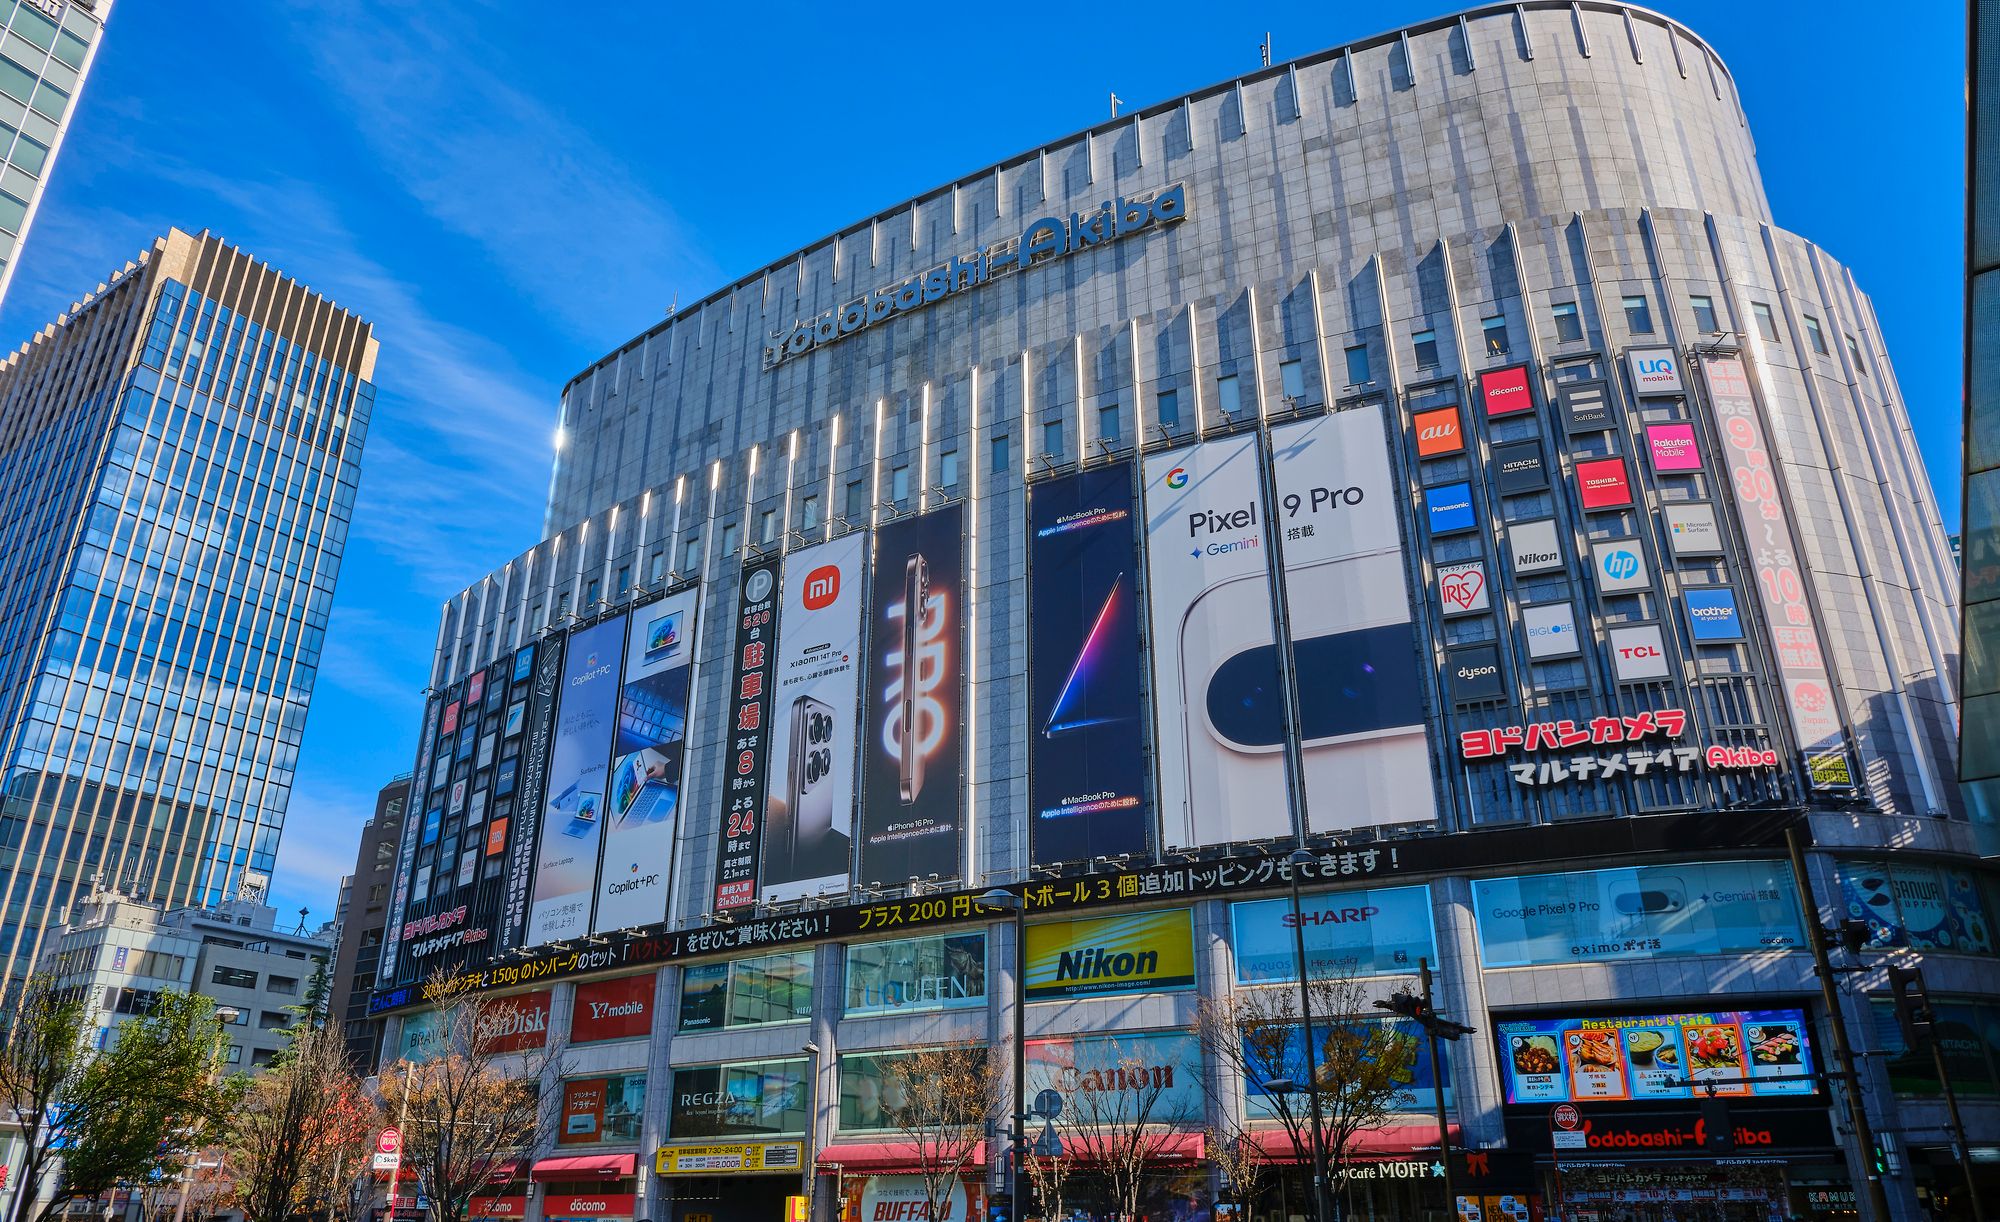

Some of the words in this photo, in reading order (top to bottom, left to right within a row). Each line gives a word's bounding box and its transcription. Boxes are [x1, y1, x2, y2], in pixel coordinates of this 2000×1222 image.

[766, 186, 1185, 365] Yodobashi-Akiba
[1639, 359, 1673, 375] UQ
[1642, 374, 1674, 383] mobile
[1489, 385, 1524, 397] docomo
[1574, 412, 1606, 422] SoftBank
[1420, 423, 1457, 441] au
[1653, 437, 1693, 449] Rakuten
[1655, 448, 1685, 457] Mobile
[1503, 458, 1538, 469] HITACHI
[1586, 477, 1618, 486] TOSHIBA
[1061, 509, 1094, 523] MacBook
[1094, 507, 1106, 515] Pro
[1190, 501, 1257, 538] Pixel
[1283, 493, 1302, 518] 9
[1310, 486, 1364, 513] Pro
[1432, 502, 1469, 513] Panasonic
[1038, 528, 1056, 537] Apple
[1206, 535, 1259, 557] Gemini
[1286, 525, 1315, 541] 搭載
[1518, 551, 1558, 566] Nikon
[1609, 551, 1634, 579] hp
[1760, 566, 1801, 604] 10
[1691, 607, 1733, 617] brother
[743, 610, 770, 630] 520
[750, 628, 760, 640] 台
[1529, 624, 1573, 637] BIGLOBE
[820, 653, 831, 661] 14T
[1619, 646, 1660, 659] TCL
[883, 593, 945, 760] PRO
[1457, 664, 1496, 680] dyson
[738, 641, 766, 731] 駐車場
[1461, 709, 1686, 759] ヨドバシカメラ
[737, 735, 759, 750] あさ
[738, 750, 754, 775] 8
[1509, 747, 1700, 786] マルチメディア
[1705, 745, 1778, 769] Akiba
[580, 767, 597, 776] Surface
[732, 778, 755, 790] 時から
[732, 796, 753, 811] よる
[1067, 792, 1101, 805] MacBook
[1102, 791, 1115, 799] Pro
[1041, 809, 1061, 818] Apple
[727, 810, 754, 838] 24
[893, 822, 915, 831] iPhone
[915, 819, 922, 827] 16
[923, 818, 934, 826] Pro
[727, 840, 751, 853] 時まで
[870, 834, 887, 844] Apple
[724, 856, 752, 869] 高さ制限
[724, 868, 750, 880] 2.1mまで
[608, 873, 660, 895] Copilot+PC
[1713, 890, 1756, 903] Gemini
[1758, 888, 1780, 902] 搭載
[858, 905, 903, 930] プラス
[909, 901, 946, 922] 200
[1097, 879, 1111, 899] 3
[1492, 905, 1536, 920] Google
[1538, 902, 1566, 915] Pixel
[1568, 901, 1576, 913] 9
[1579, 900, 1600, 912] Pro
[403, 905, 467, 940] ヨドバシカメラ
[1282, 906, 1380, 929] SHARP
[412, 931, 464, 958] マルチメディア
[463, 928, 488, 945] Akiba
[1760, 935, 1794, 944] docomo
[1571, 941, 1620, 956] eximo
[1056, 947, 1158, 982] Nikon
[1251, 960, 1291, 973] AQUOS
[491, 964, 519, 985] 150g
[683, 1016, 711, 1026] Panasonic
[1581, 1016, 1665, 1031] Restaurant
[1666, 1016, 1676, 1027] &
[1679, 1014, 1713, 1026] Cafe
[1054, 1063, 1174, 1093] Canon
[573, 1101, 596, 1110] ブラザー
[681, 1092, 735, 1107] REGZA
[1349, 1163, 1376, 1179] Café
[1597, 1174, 1663, 1183] ヨドバシカメラ
[1663, 1174, 1708, 1183] マルチメディア
[570, 1199, 606, 1212] docomo
[873, 1201, 953, 1222] BUFFAO
